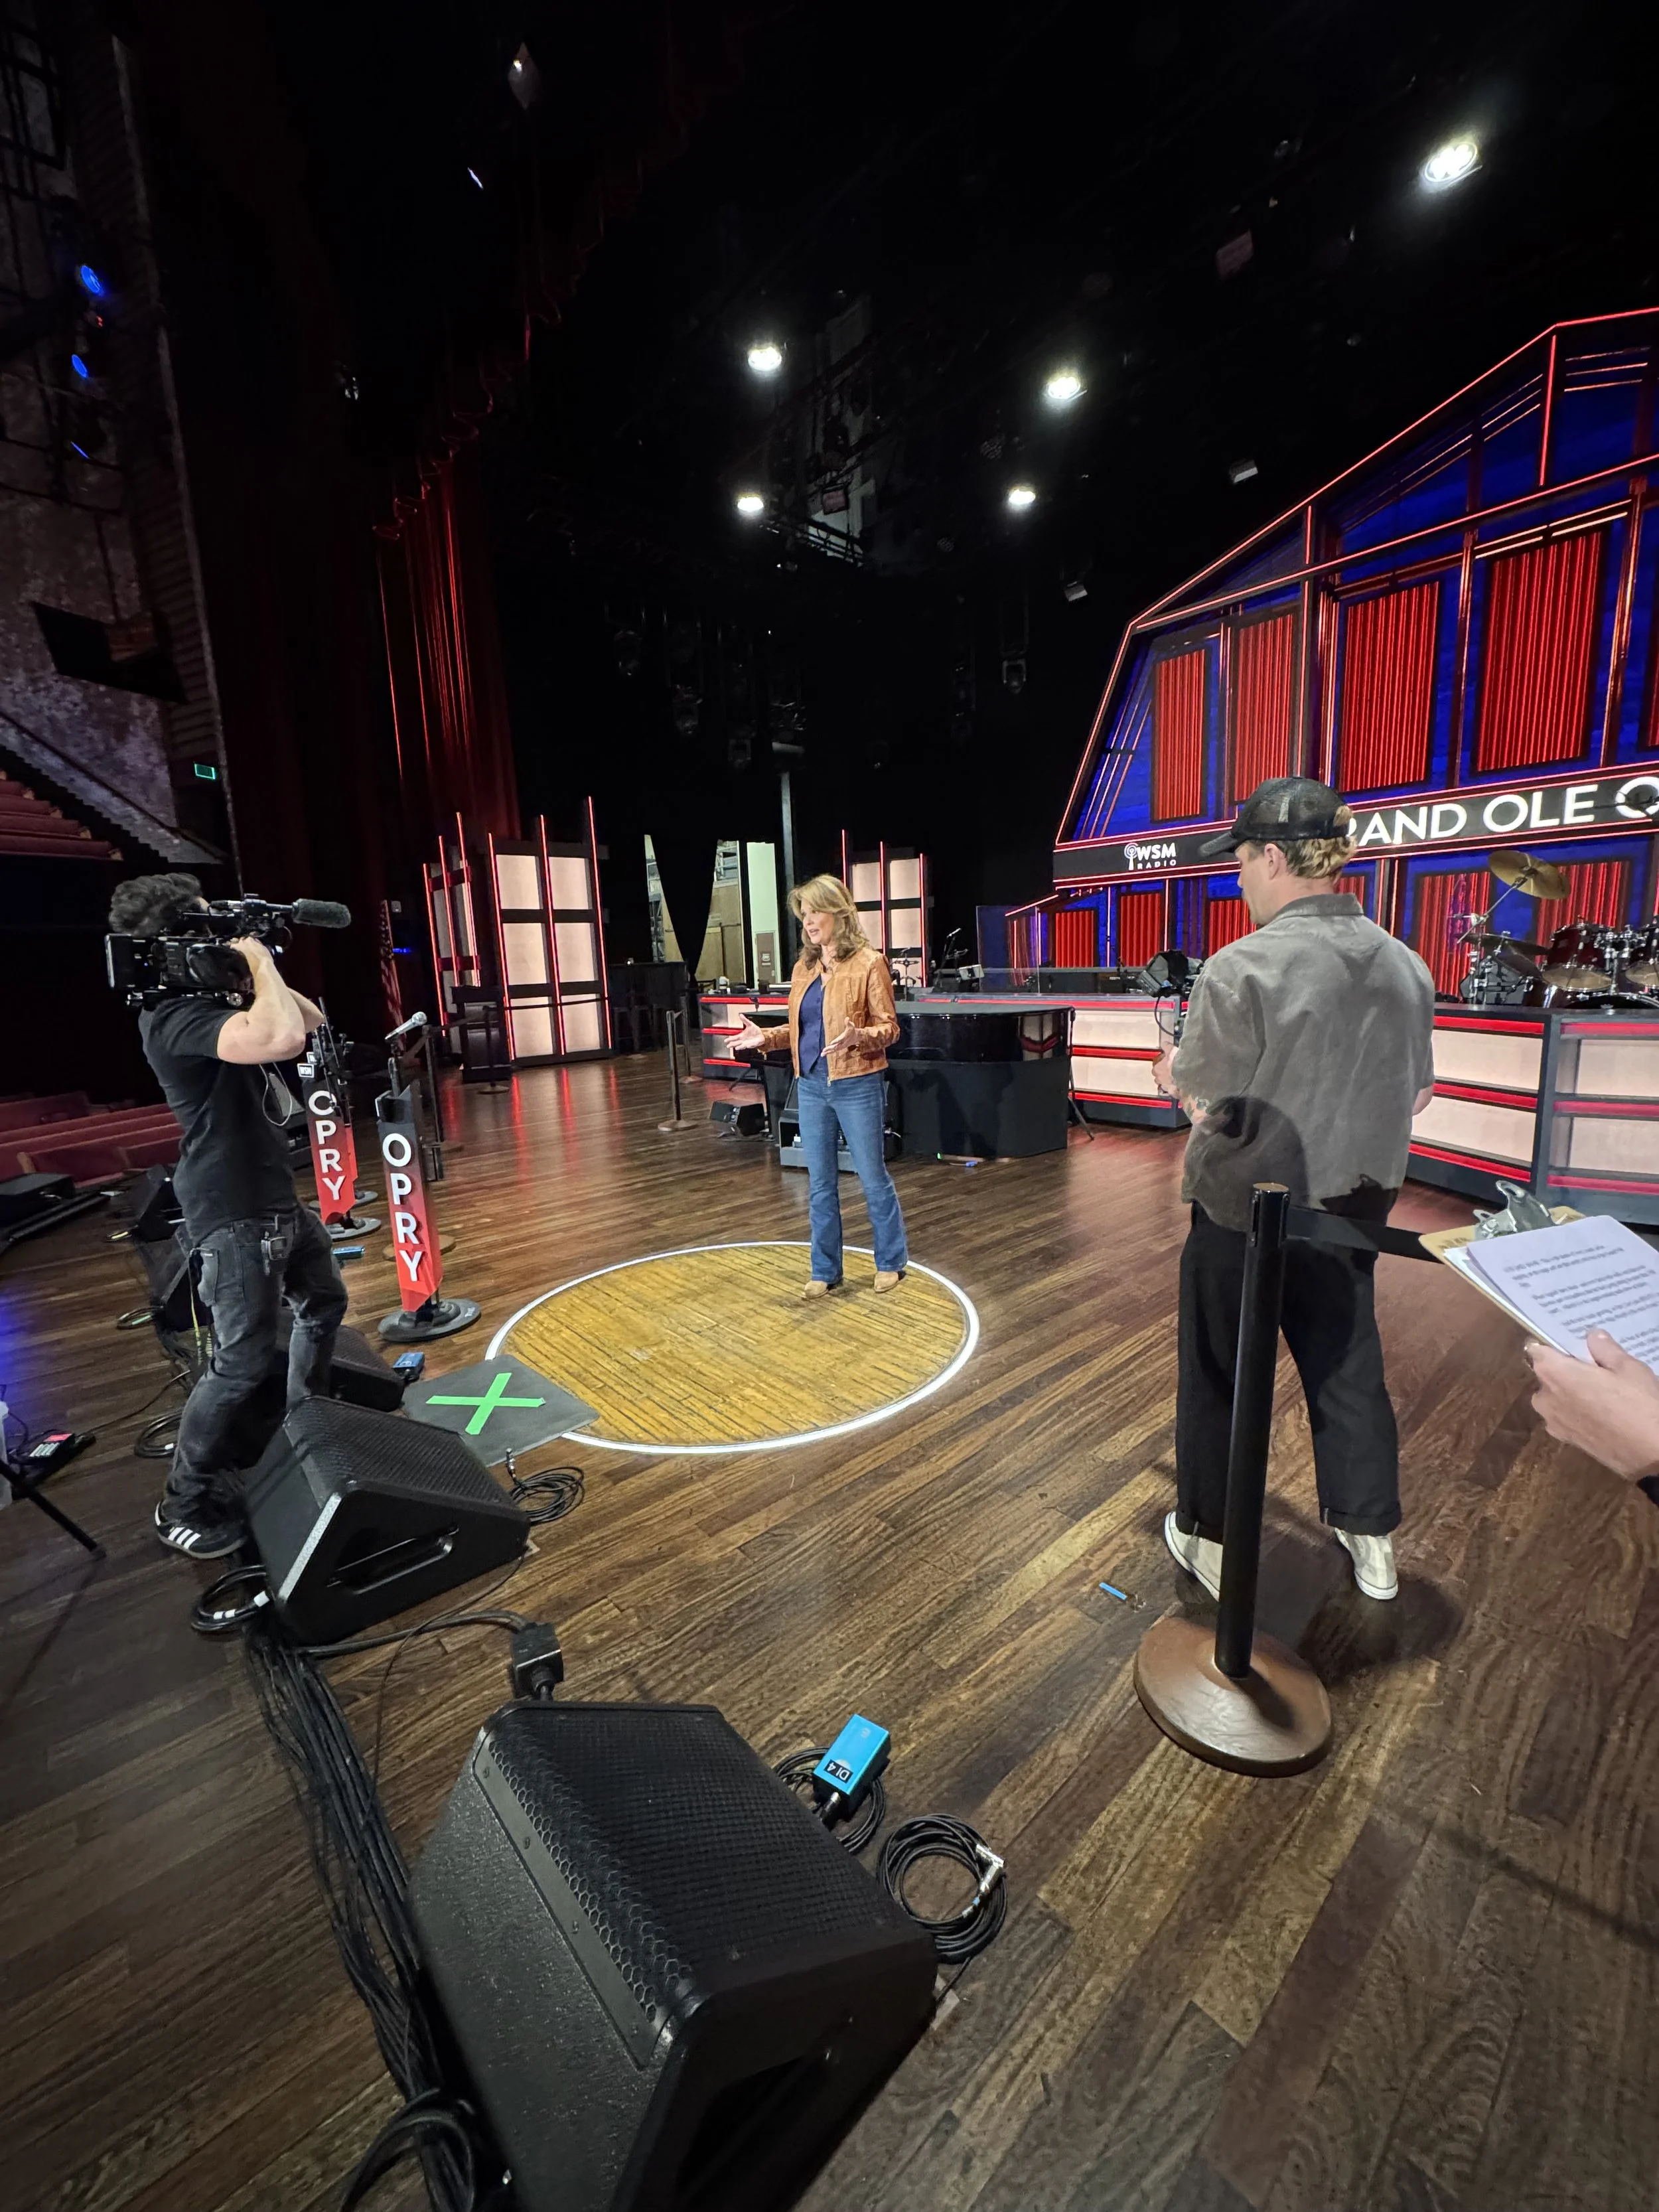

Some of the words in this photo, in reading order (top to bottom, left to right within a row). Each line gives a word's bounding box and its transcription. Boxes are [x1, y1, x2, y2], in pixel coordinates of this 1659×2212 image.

[1482, 784, 1598, 833] OLE
[1137, 842, 1177, 861] WSM
[1137, 859, 1177, 869] RADIO
[308, 1090, 344, 1201] OPRY
[382, 1132, 423, 1282] OPRY
